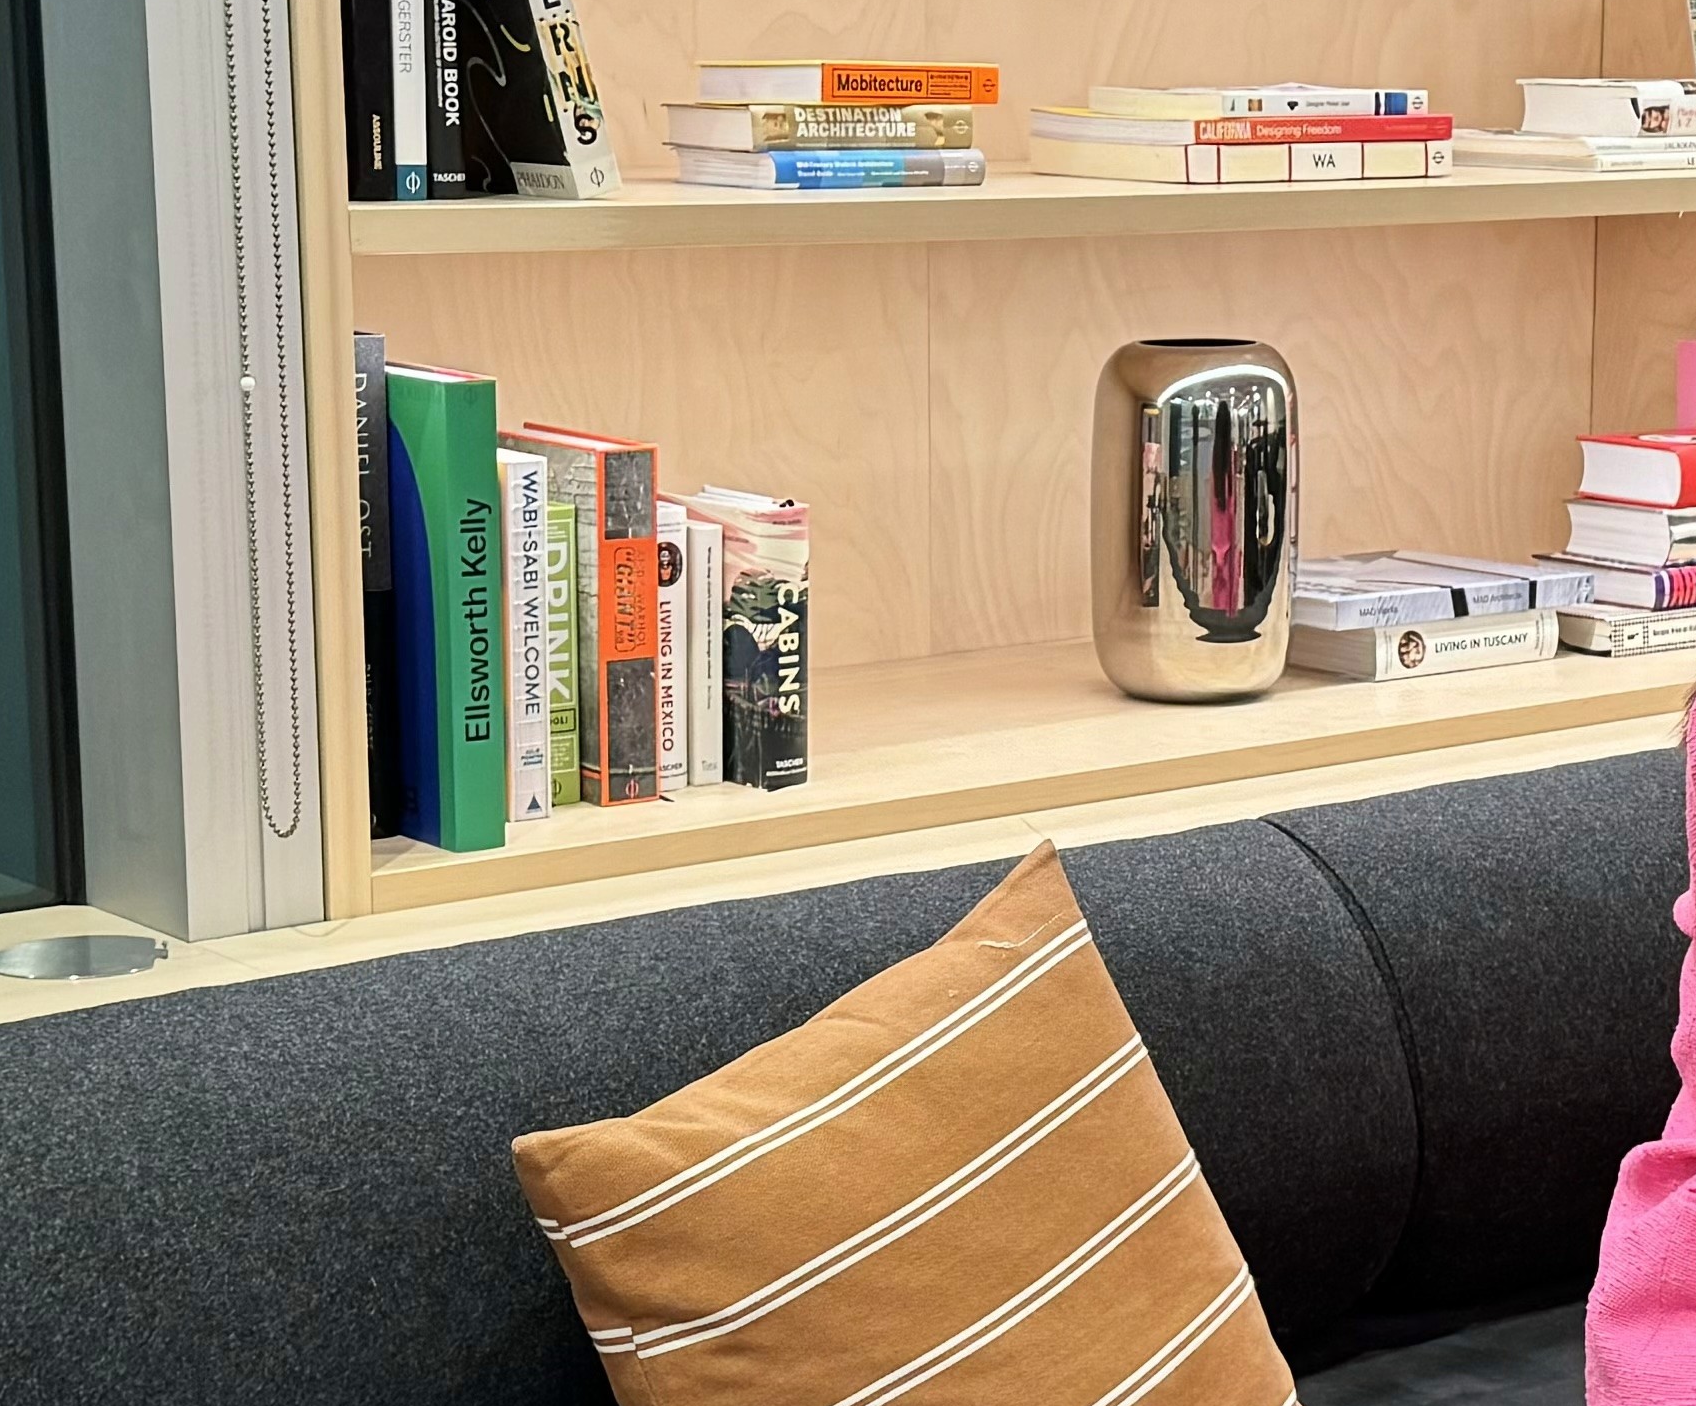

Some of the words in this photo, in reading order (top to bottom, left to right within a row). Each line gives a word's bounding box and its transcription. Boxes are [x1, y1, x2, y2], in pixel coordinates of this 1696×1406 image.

[397, 0, 413, 74] GERSTER
[443, 68, 461, 127] BOOK
[837, 73, 923, 93] Mobitecture
[794, 107, 903, 123] DESTINATION
[796, 122, 916, 138] ARCHITECTURE
[1199, 121, 1252, 140] CALIFORNIA
[1256, 124, 1302, 139] Designing
[1302, 124, 1342, 135] Freedom
[517, 171, 565, 190] PHAIDON
[1313, 153, 1336, 168] WA
[459, 498, 492, 573] Kelly
[522, 470, 539, 595] WABI-SABI
[659, 600, 672, 656] LIVING
[777, 582, 801, 716] CABINS
[1435, 640, 1468, 654] LIVING
[1470, 638, 1482, 649] IN
[1484, 632, 1529, 648] TUSCANY
[464, 578, 491, 744] Ellsworth
[523, 597, 541, 716] WELCOME
[660, 661, 673, 680] IN
[661, 685, 674, 752] MEXICO
